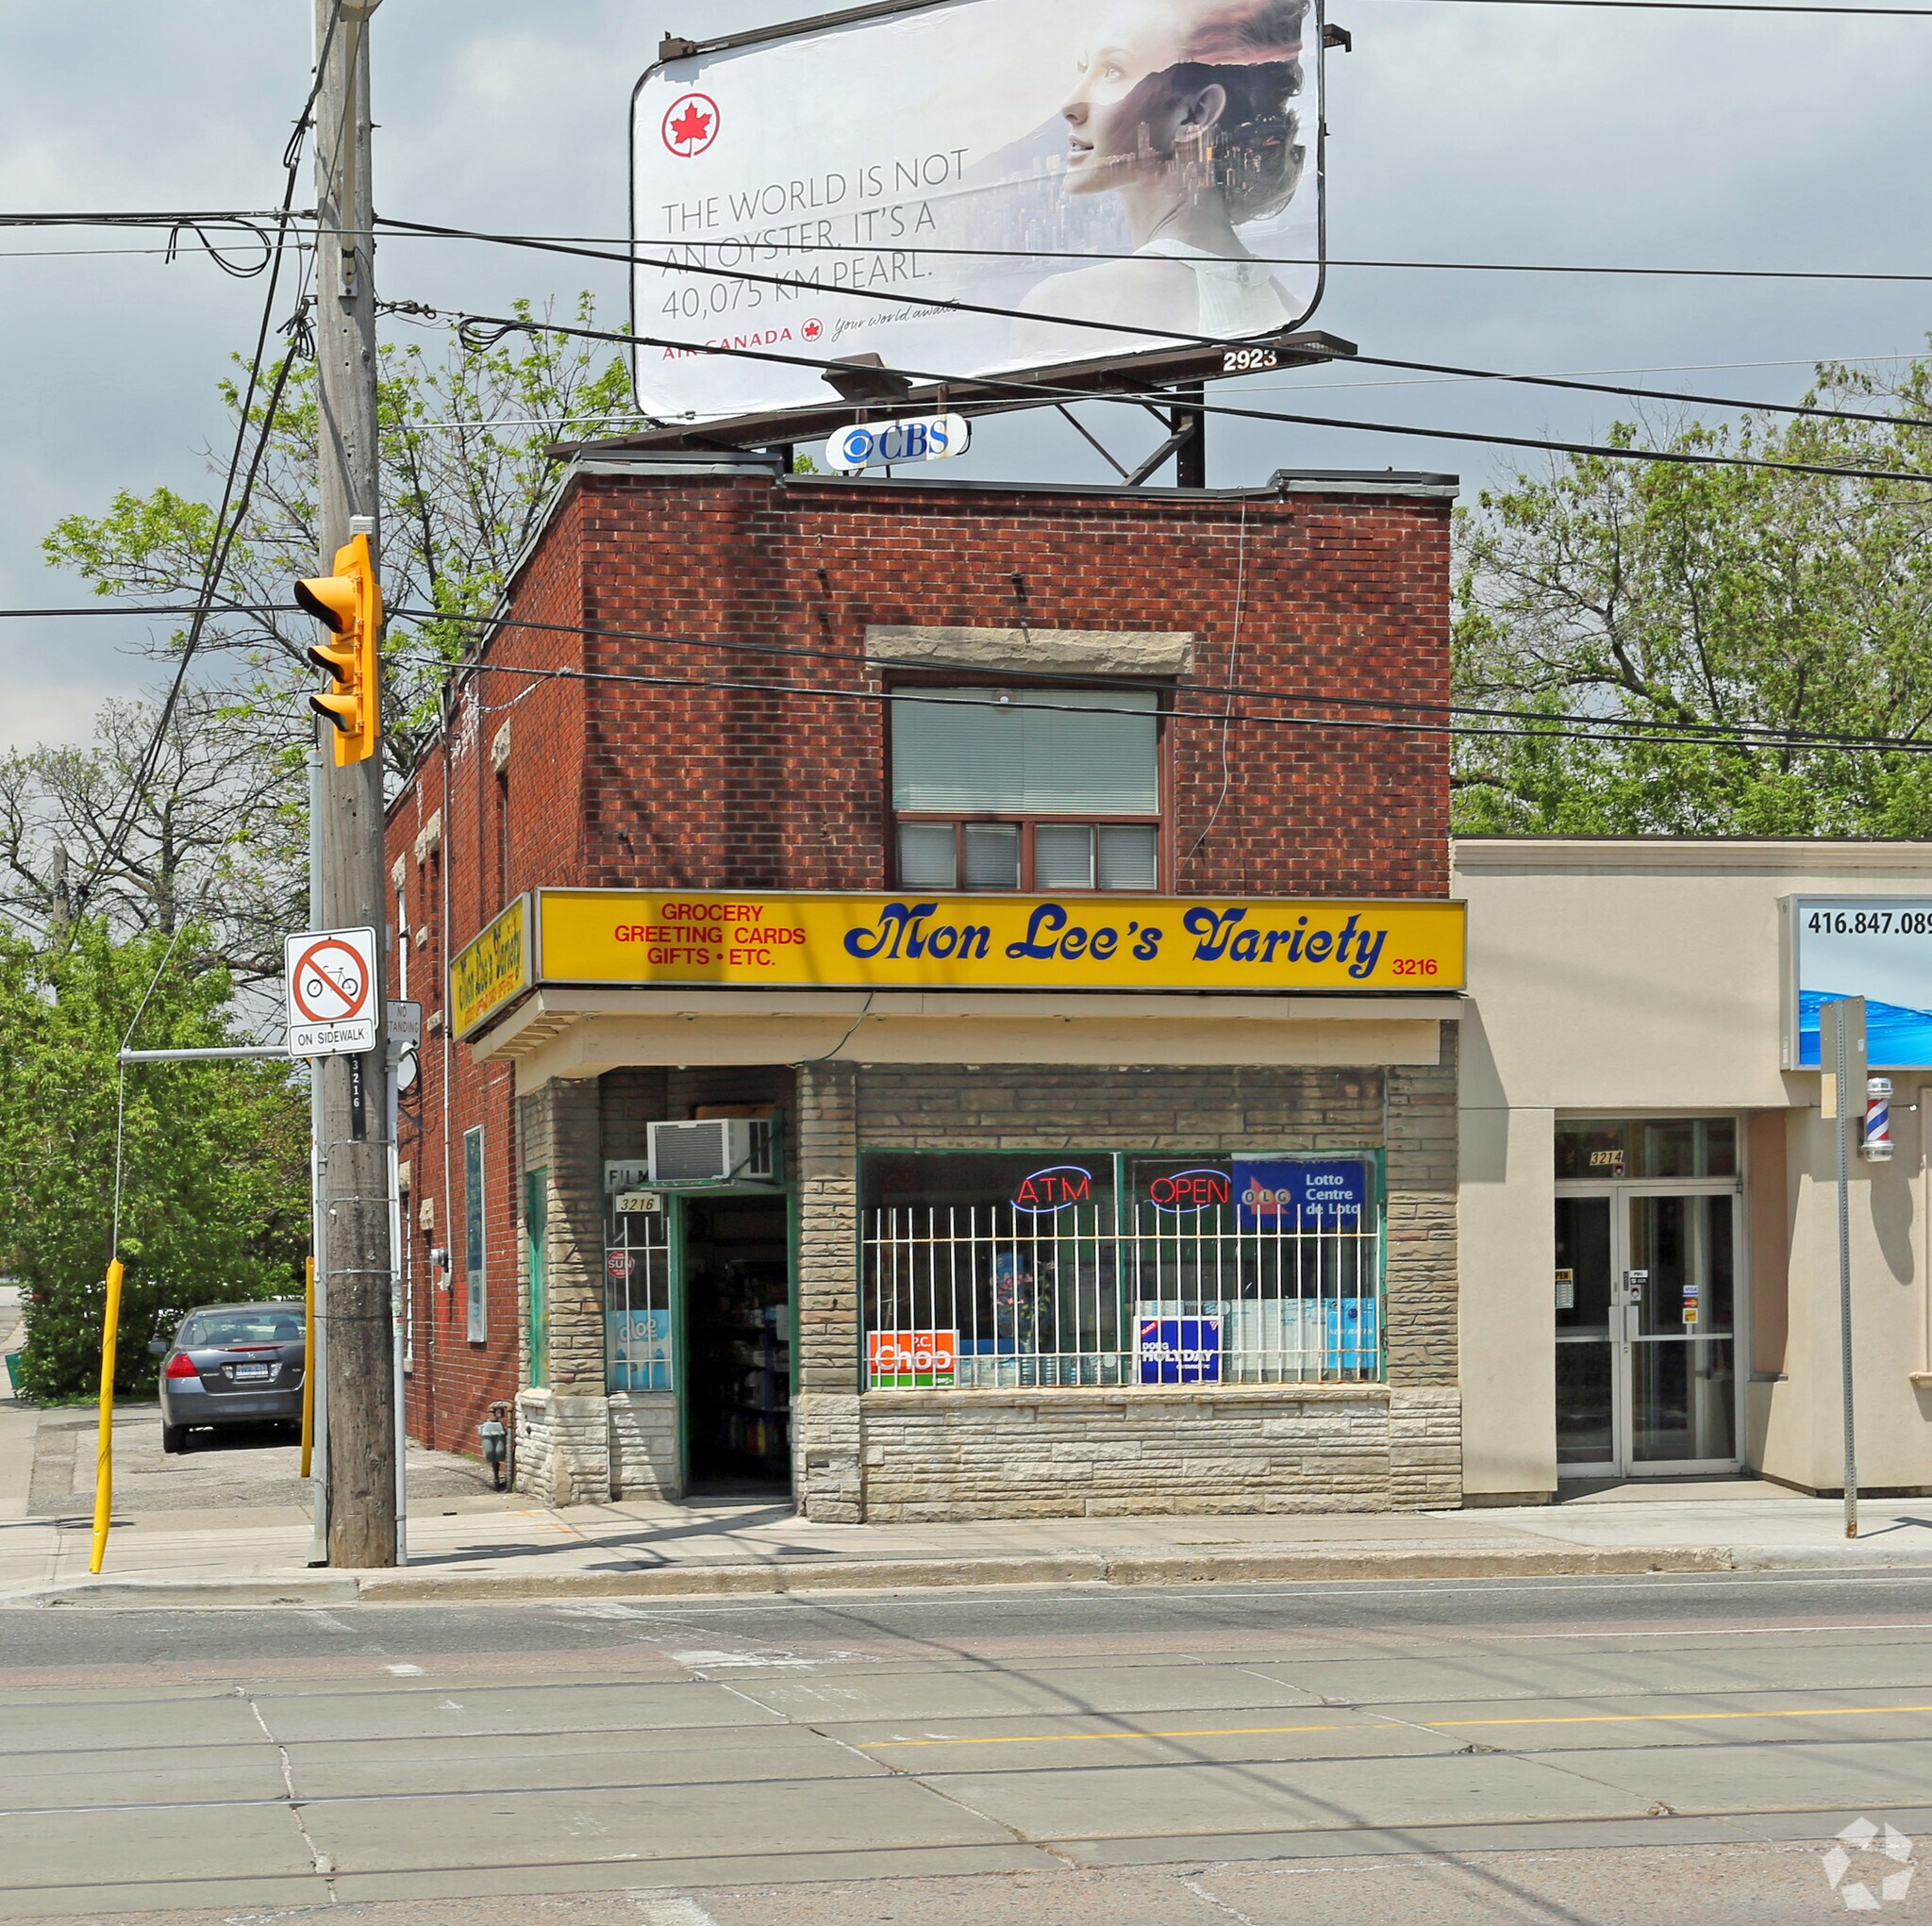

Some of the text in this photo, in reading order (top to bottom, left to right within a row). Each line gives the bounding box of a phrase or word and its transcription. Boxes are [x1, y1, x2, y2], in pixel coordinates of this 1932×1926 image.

[661, 148, 970, 234] THE WORLD IS NOT
[661, 201, 937, 278] AN OYSTER. IT'S A
[661, 249, 933, 321] 40,075 KM PEARL.
[705, 327, 793, 355] CANADA
[868, 305, 913, 327] world
[1223, 348, 1277, 372] 2923
[879, 420, 949, 459] CBS
[661, 903, 763, 922] GROCERY
[614, 925, 807, 945] GREETING CARDS
[843, 902, 1389, 979] Mon Lee's Variety
[647, 947, 776, 966] GIFTS ETC.
[1391, 958, 1439, 975] 3216
[396, 1005, 408, 1018] NO
[387, 1021, 419, 1034] TANDING
[297, 1028, 366, 1047] ON SIDEWALK
[1591, 1151, 1623, 1165] 3214
[608, 1169, 649, 1186] FILM
[1306, 1173, 1344, 1186] Lotto
[1017, 1176, 1091, 1204] ATM
[1150, 1177, 1229, 1204] OPEN
[1243, 1189, 1289, 1204] OLG
[1306, 1188, 1354, 1201] Centre
[620, 1198, 655, 1211] 3216
[1306, 1203, 1359, 1215] de Loto
[608, 1258, 632, 1269] SUN
[1141, 1349, 1214, 1363] HOLYDAY
